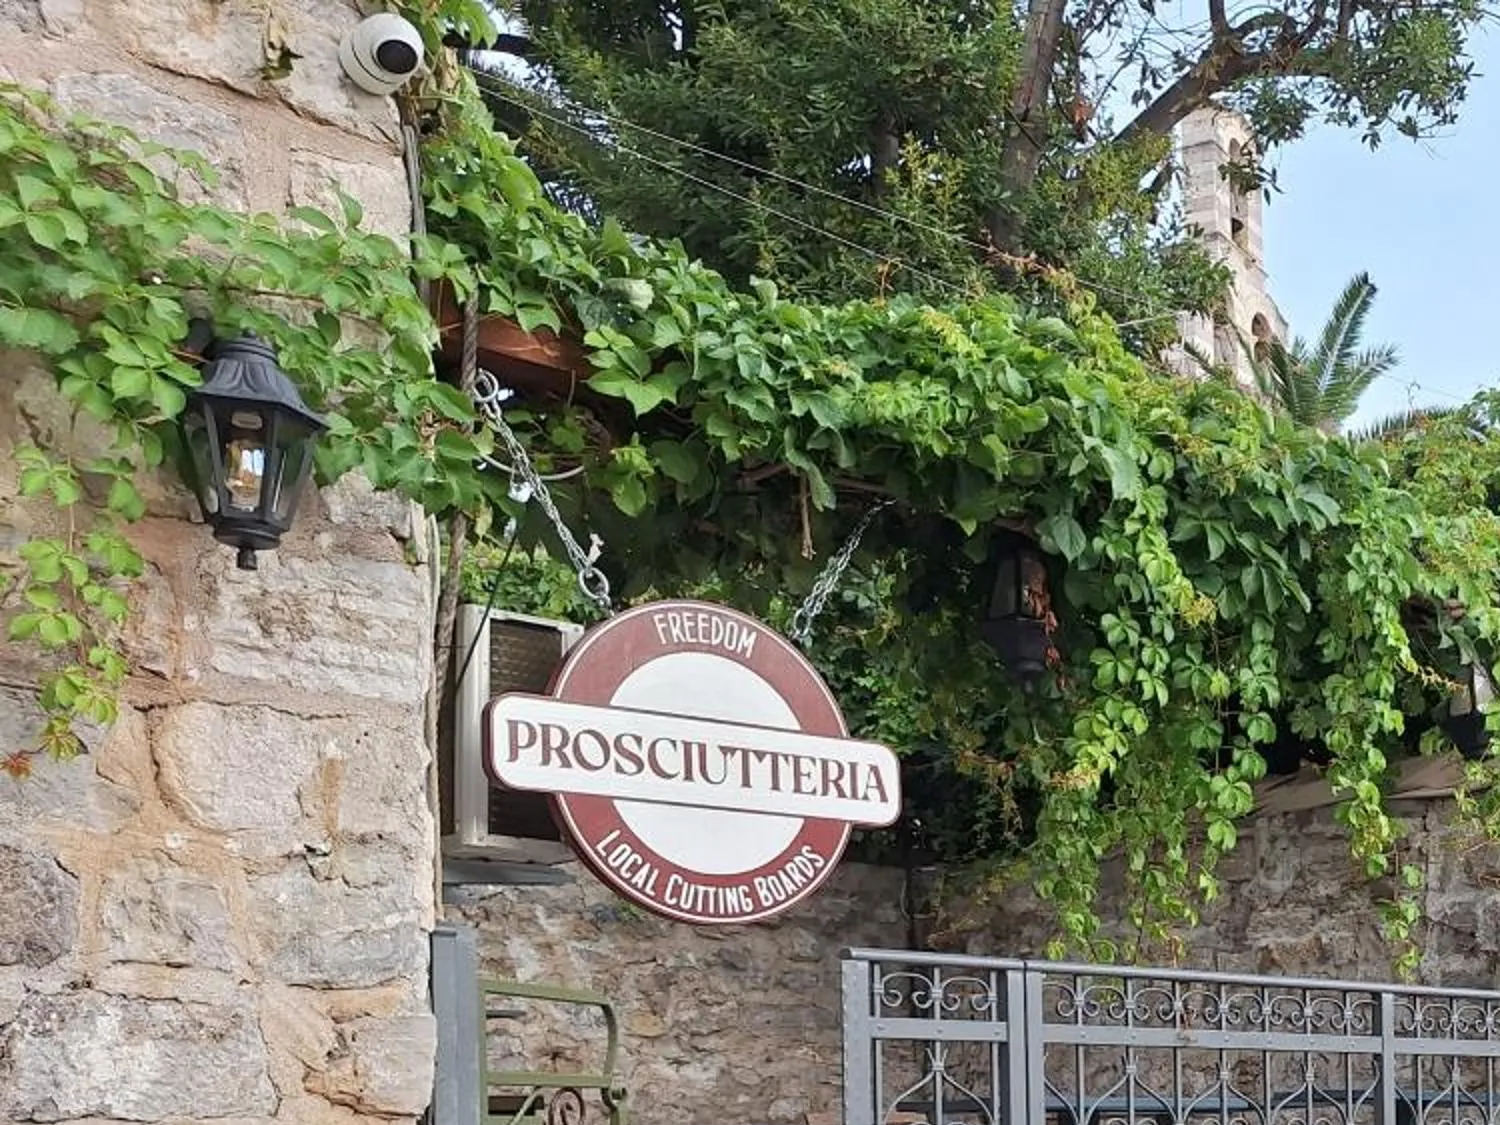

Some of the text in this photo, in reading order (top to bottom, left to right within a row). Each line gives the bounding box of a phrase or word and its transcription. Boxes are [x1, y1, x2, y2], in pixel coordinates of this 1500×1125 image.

[654, 612, 758, 658] FREEDOM
[506, 719, 889, 803] PROSCIUTTERIA
[595, 829, 825, 915] LOCAL CUTTING BOARDS
